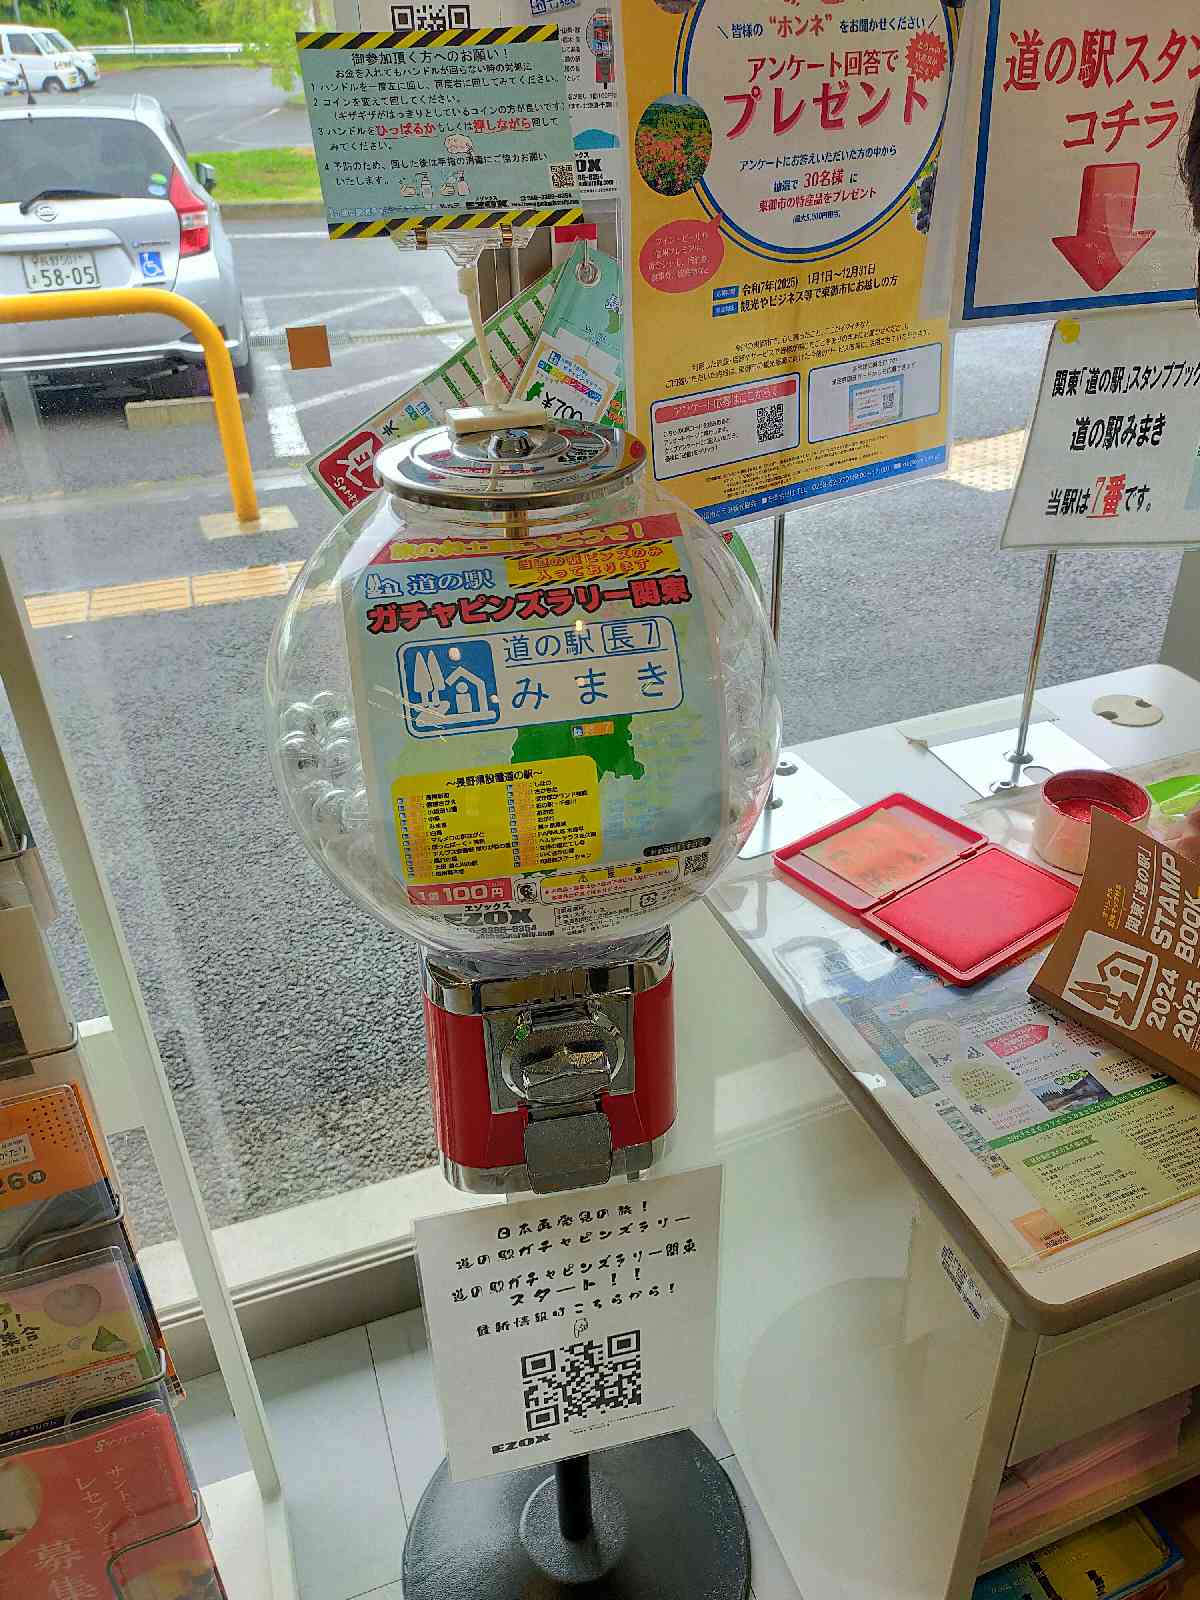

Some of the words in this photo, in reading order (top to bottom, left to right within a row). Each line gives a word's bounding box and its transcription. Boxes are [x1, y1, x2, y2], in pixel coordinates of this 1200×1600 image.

[731, 23, 763, 39] 皆様の
[839, 16, 925, 34] をお聞かせください
[747, 49, 899, 82] アンケート回答で
[723, 75, 929, 140] プレゼント
[1062, 98, 1180, 153] コチラ
[739, 144, 897, 172] アンケートにお答えいただいた方の中から
[803, 168, 845, 188] 30名様
[849, 172, 858, 184] に
[40, 266, 95, 287] 58-05
[1070, 412, 1167, 451] 道の駅みまき
[1045, 473, 1152, 516] 当駅は7番です。
[406, 568, 497, 596] 道の駅
[366, 574, 693, 636] ガチャピンズラリー関東
[503, 631, 593, 663] 道の駅
[511, 661, 668, 710] みまき
[464, 902, 511, 912] エゾックス
[1150, 851, 1183, 950] STAMP
[1174, 890, 1200, 965] BOOK
[1146, 967, 1179, 1031] 2024
[1173, 979, 1200, 1043] 2025
[491, 1432, 551, 1455] EZOX
